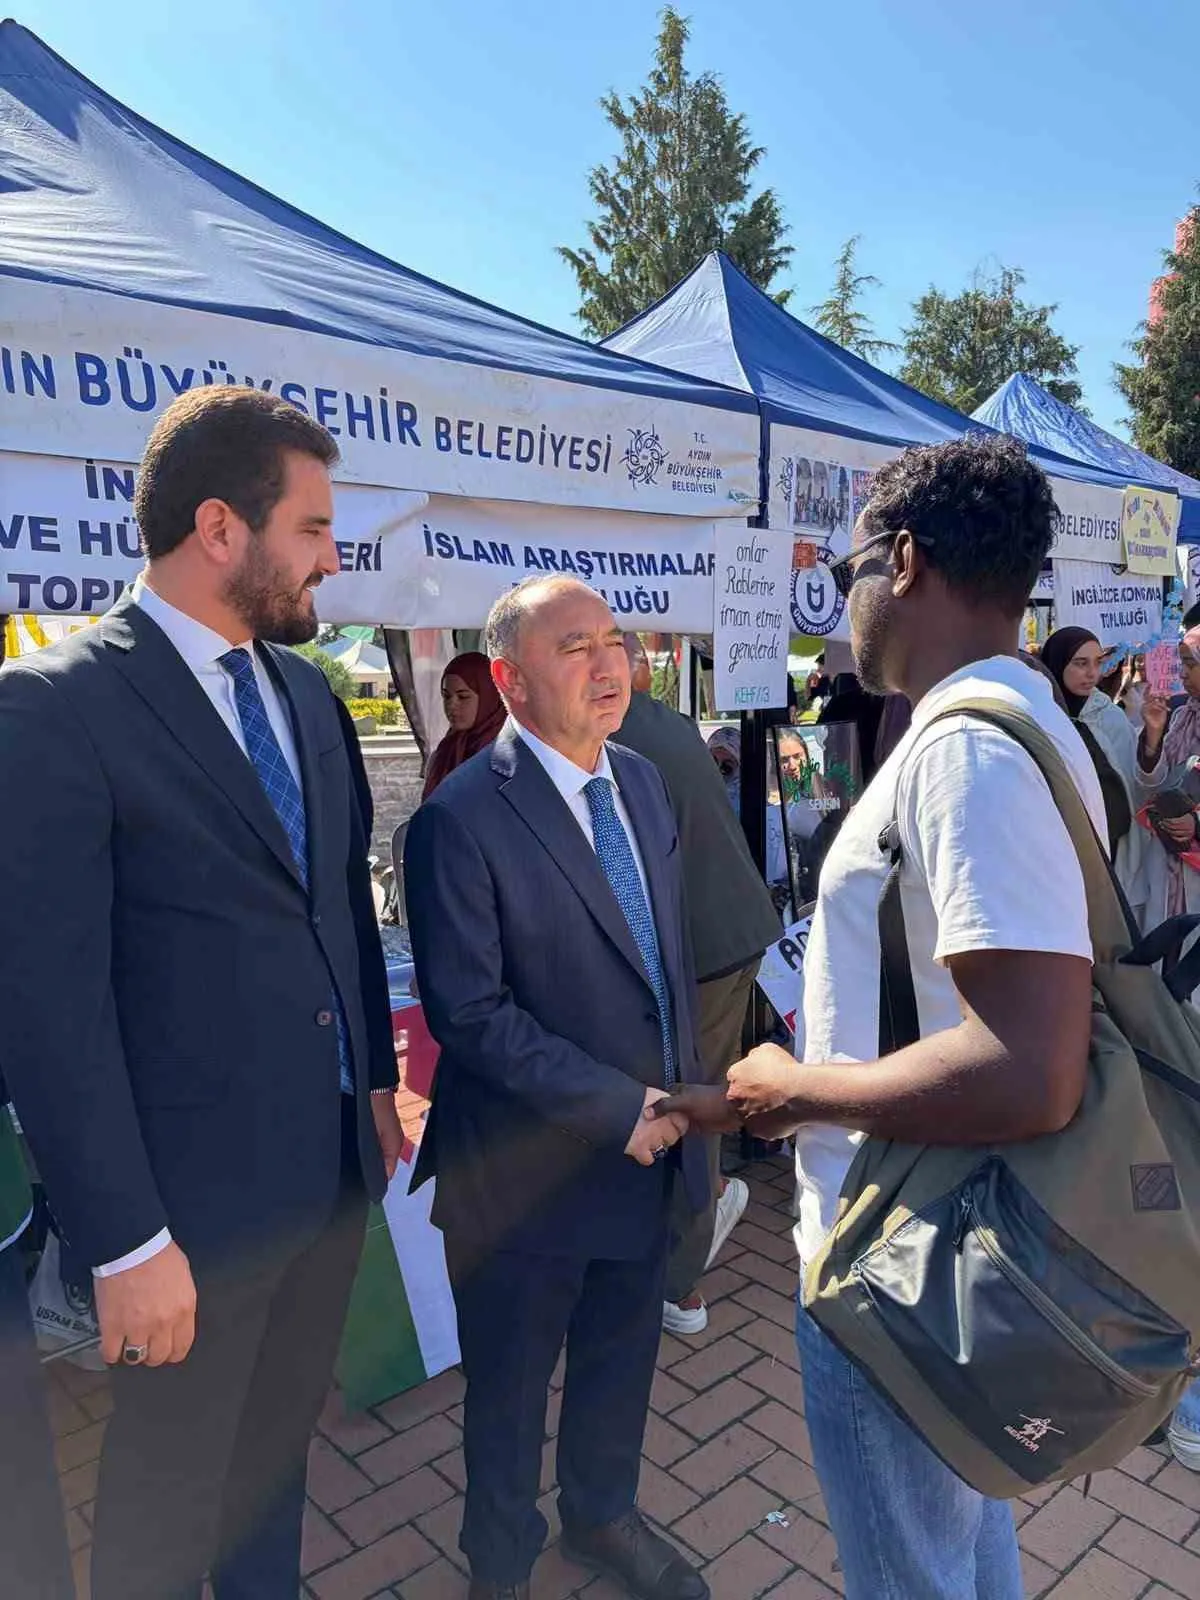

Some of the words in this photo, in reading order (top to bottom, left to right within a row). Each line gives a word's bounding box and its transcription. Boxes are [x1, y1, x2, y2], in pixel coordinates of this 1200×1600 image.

[75, 346, 422, 448] BÜYEHİR
[435, 416, 612, 474] BELEDİYESİ
[688, 449, 712, 461] AYDIN
[667, 462, 722, 480] BÜYÜKŞEHİR
[672, 480, 716, 495] BELEDİYESİ
[0, 514, 61, 553] VE
[423, 524, 515, 567] İSLAM
[736, 536, 769, 563] onlar
